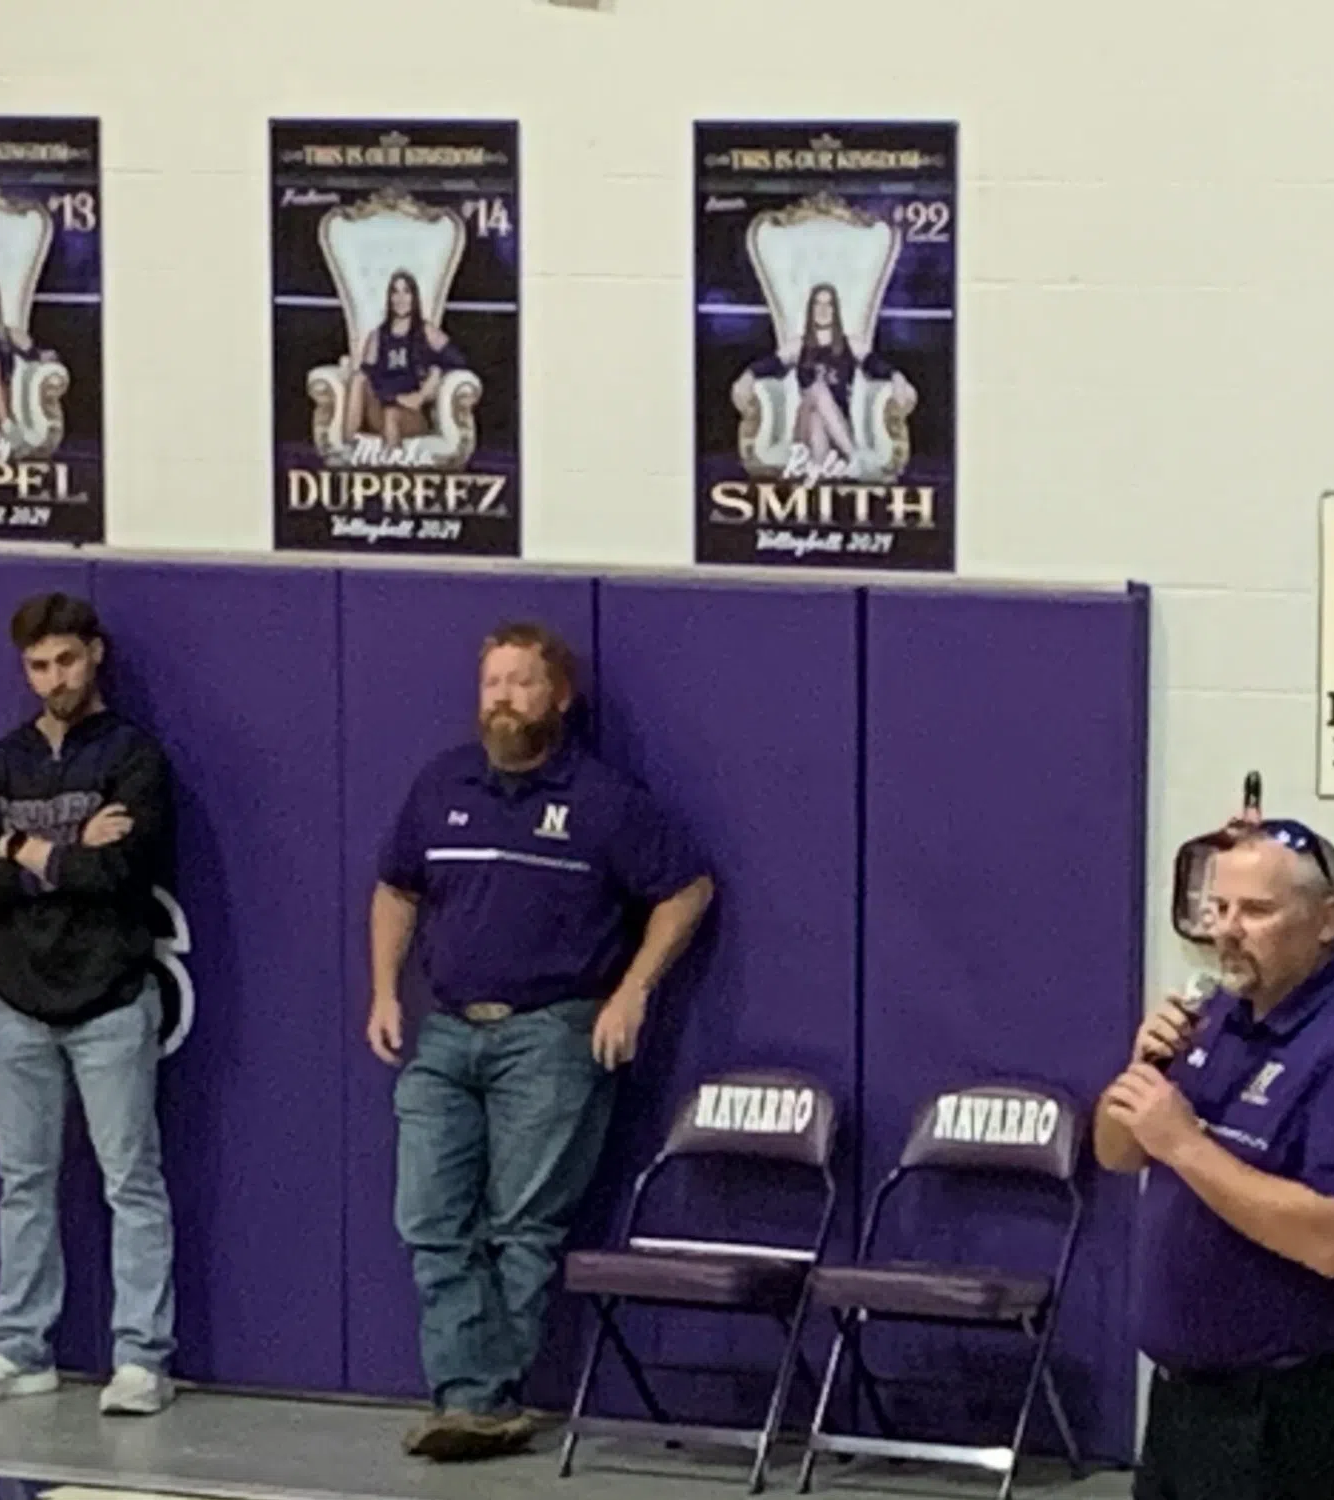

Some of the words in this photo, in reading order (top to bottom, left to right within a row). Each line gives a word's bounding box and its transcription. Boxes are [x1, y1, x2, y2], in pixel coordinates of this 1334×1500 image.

[287, 469, 511, 517] DUPREEZ
[710, 481, 936, 529] SMITH
[694, 1084, 814, 1134] NAVARRO
[933, 1094, 1058, 1146] NAVARRO
